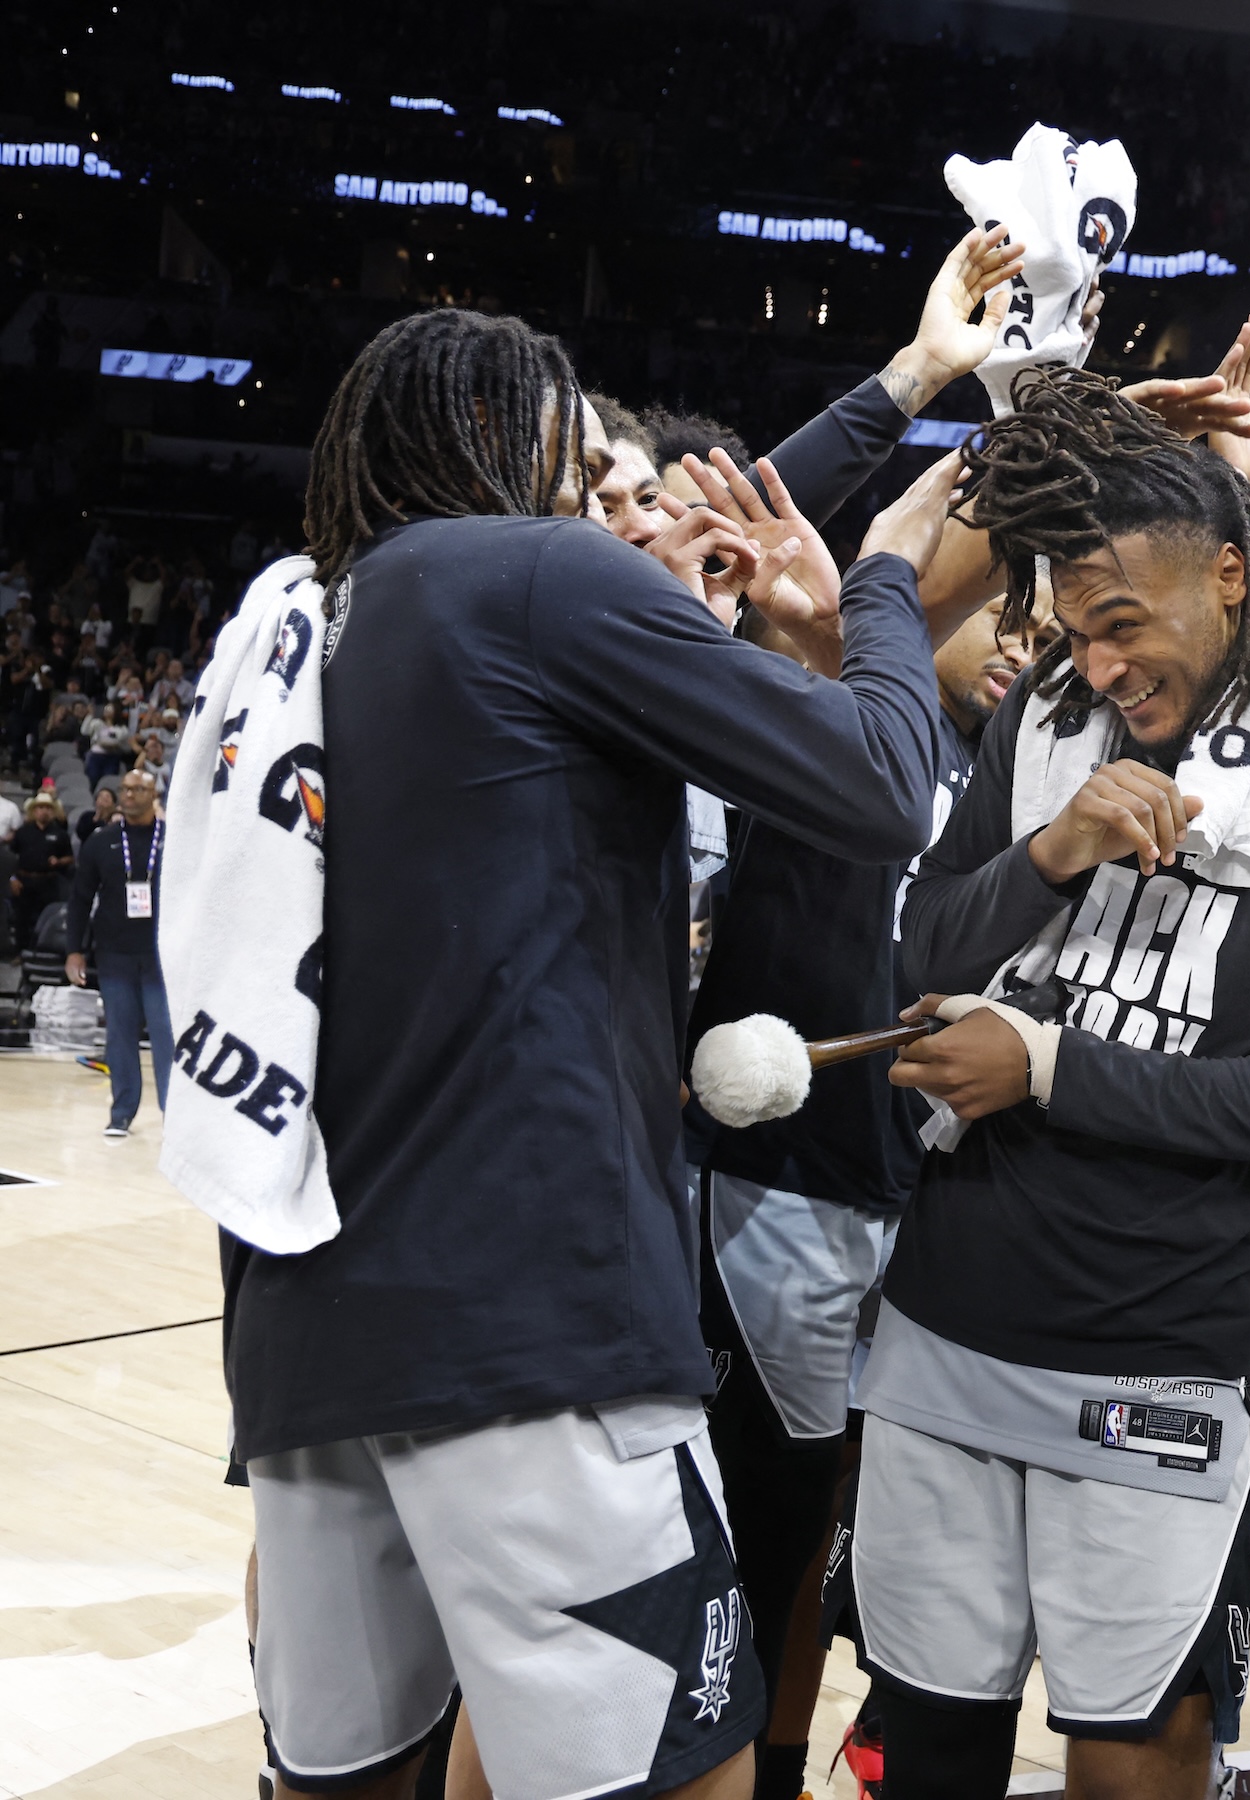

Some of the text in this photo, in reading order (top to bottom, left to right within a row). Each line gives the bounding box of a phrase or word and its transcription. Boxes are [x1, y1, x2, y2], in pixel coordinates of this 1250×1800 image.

[0, 142, 80, 167] NTONIO
[334, 173, 377, 200] SAN
[379, 180, 469, 206] ANTONIO
[718, 211, 760, 237] SAN
[761, 217, 848, 242] ANTONIO
[1127, 250, 1206, 279] ANTONIO
[1055, 861, 1239, 1021] ACK
[1063, 982, 1207, 1057] TORY
[174, 1009, 308, 1137] ADE
[1195, 1383, 1217, 1399] GO
[1131, 1418, 1143, 1427] 48
